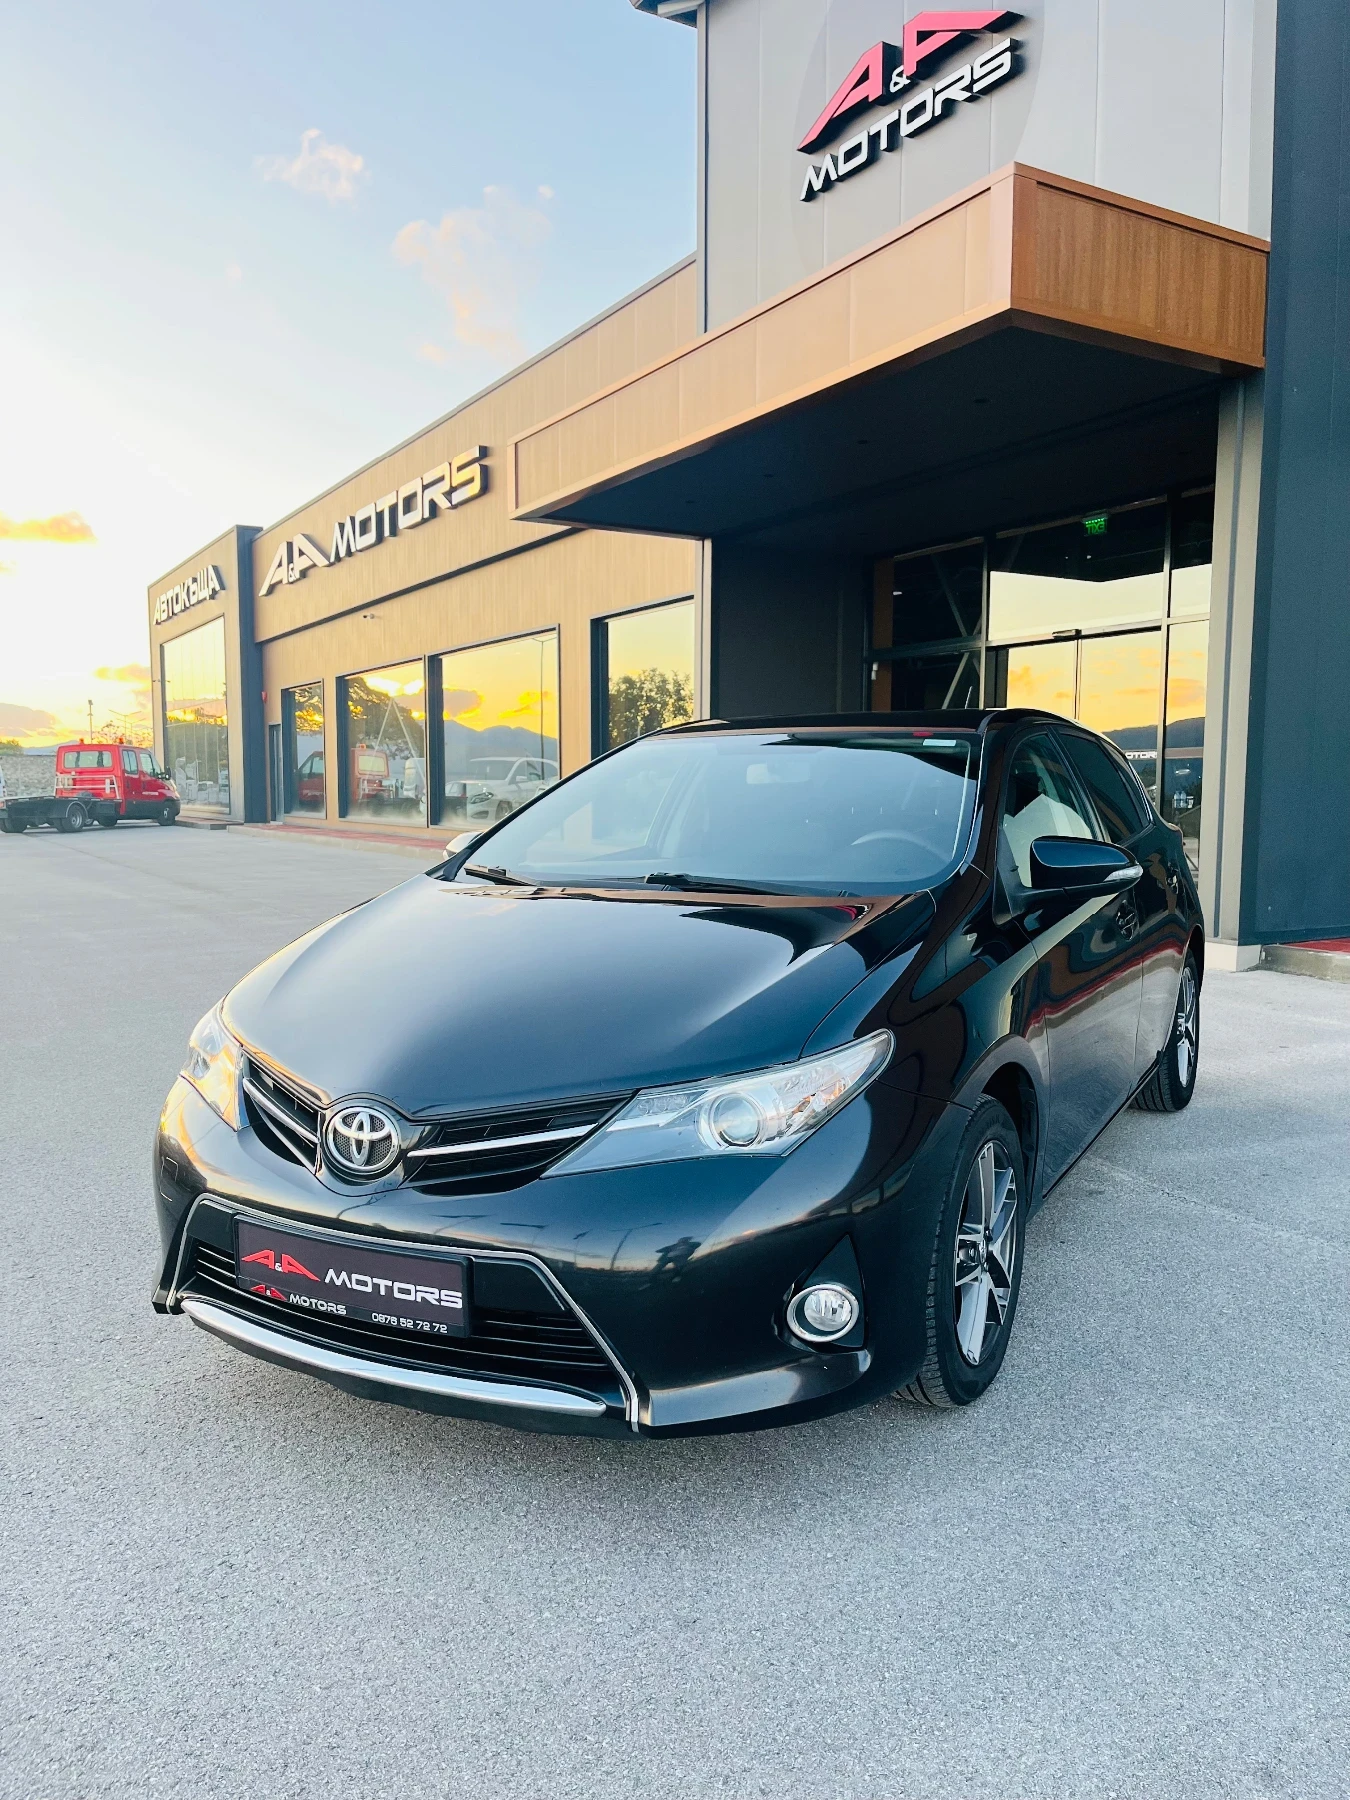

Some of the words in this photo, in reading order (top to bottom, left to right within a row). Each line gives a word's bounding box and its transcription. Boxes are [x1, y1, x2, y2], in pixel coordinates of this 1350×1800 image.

[797, 10, 1008, 150] A&A
[800, 38, 1011, 201] MOTORS
[258, 533, 332, 597] A&A
[330, 446, 481, 563] MOTORS
[153, 564, 221, 625] АВТОКЪЩА
[242, 1249, 320, 1281] A&A
[325, 1268, 462, 1309] MOTORS
[251, 1284, 287, 1301] A&A
[289, 1293, 346, 1315] MOTORS
[400, 1318, 413, 1328] 52
[416, 1321, 430, 1331] 72
[433, 1323, 447, 1333] 72
